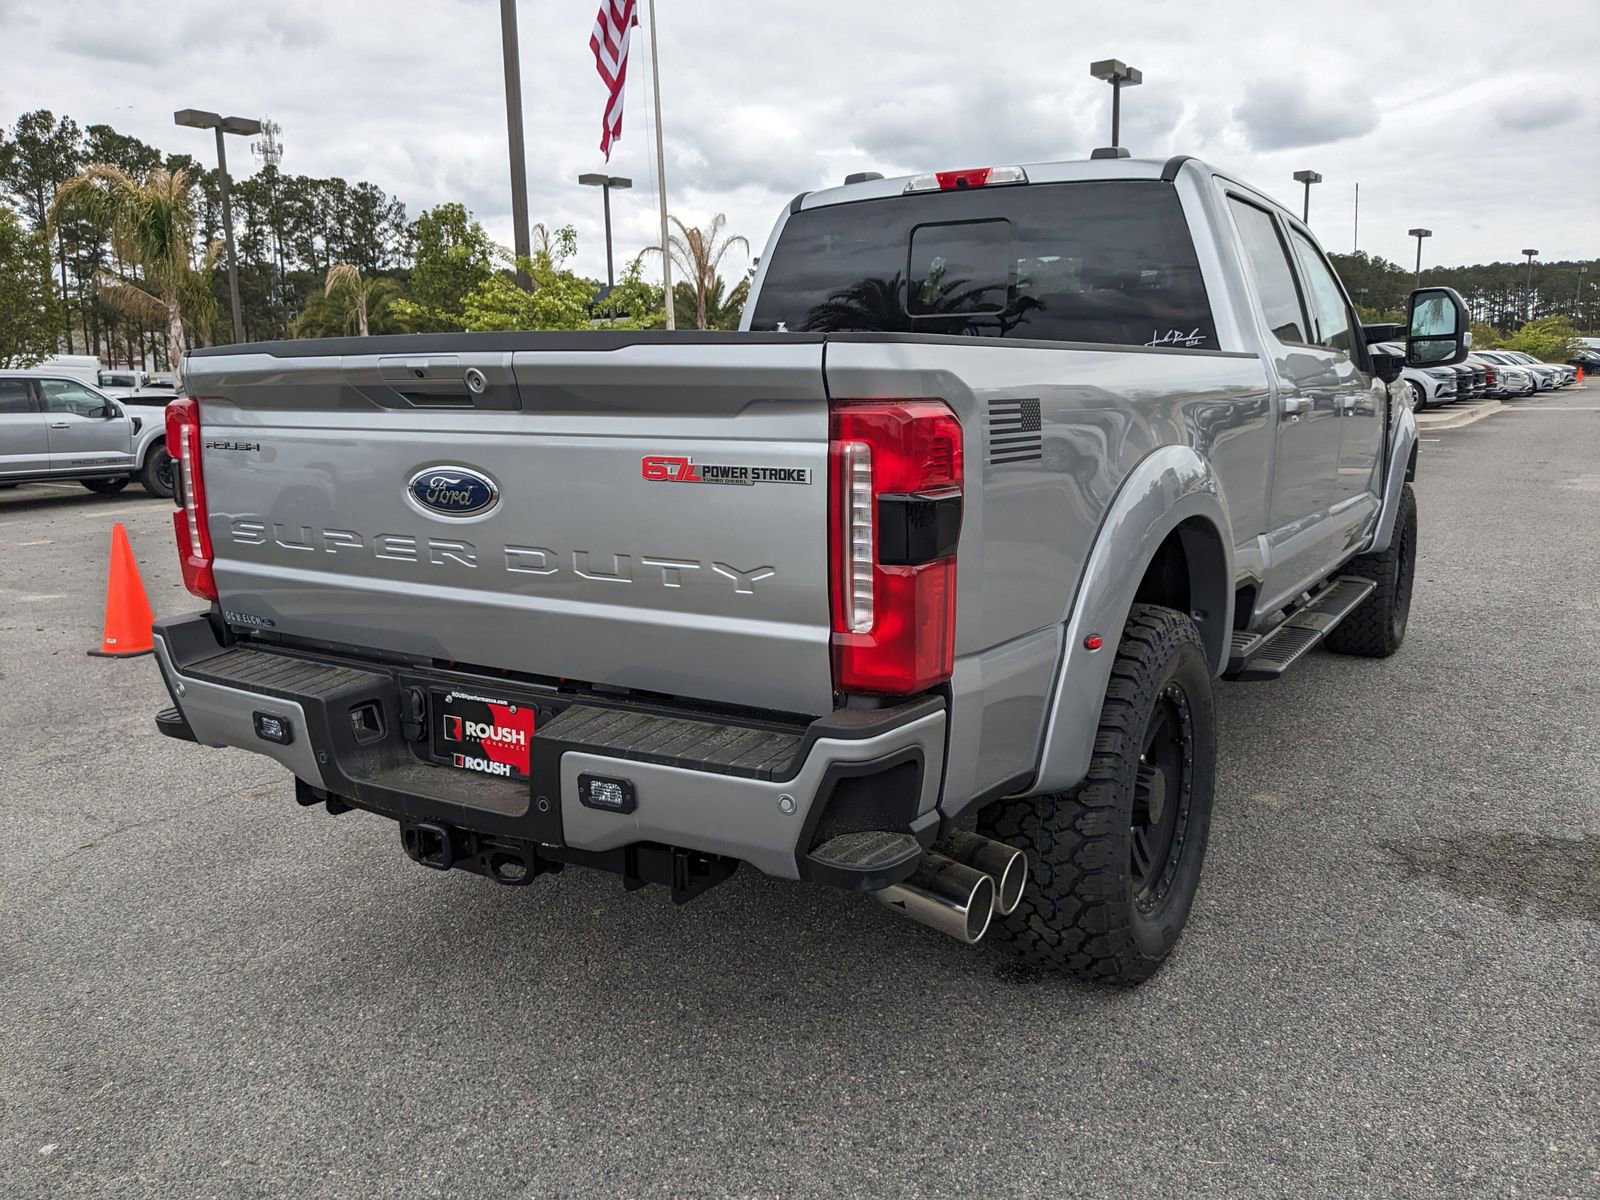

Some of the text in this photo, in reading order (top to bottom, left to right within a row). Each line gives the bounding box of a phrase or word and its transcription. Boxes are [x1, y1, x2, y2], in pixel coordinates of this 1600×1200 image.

[206, 441, 260, 451] ROUSH
[702, 465, 806, 482] POWER STROKE
[426, 476, 473, 506] Ford
[230, 519, 776, 595] SUPER DUTY
[465, 720, 526, 745] ROUSH
[466, 735, 526, 752] PERFORMANCE
[465, 756, 512, 777] ROUSH
